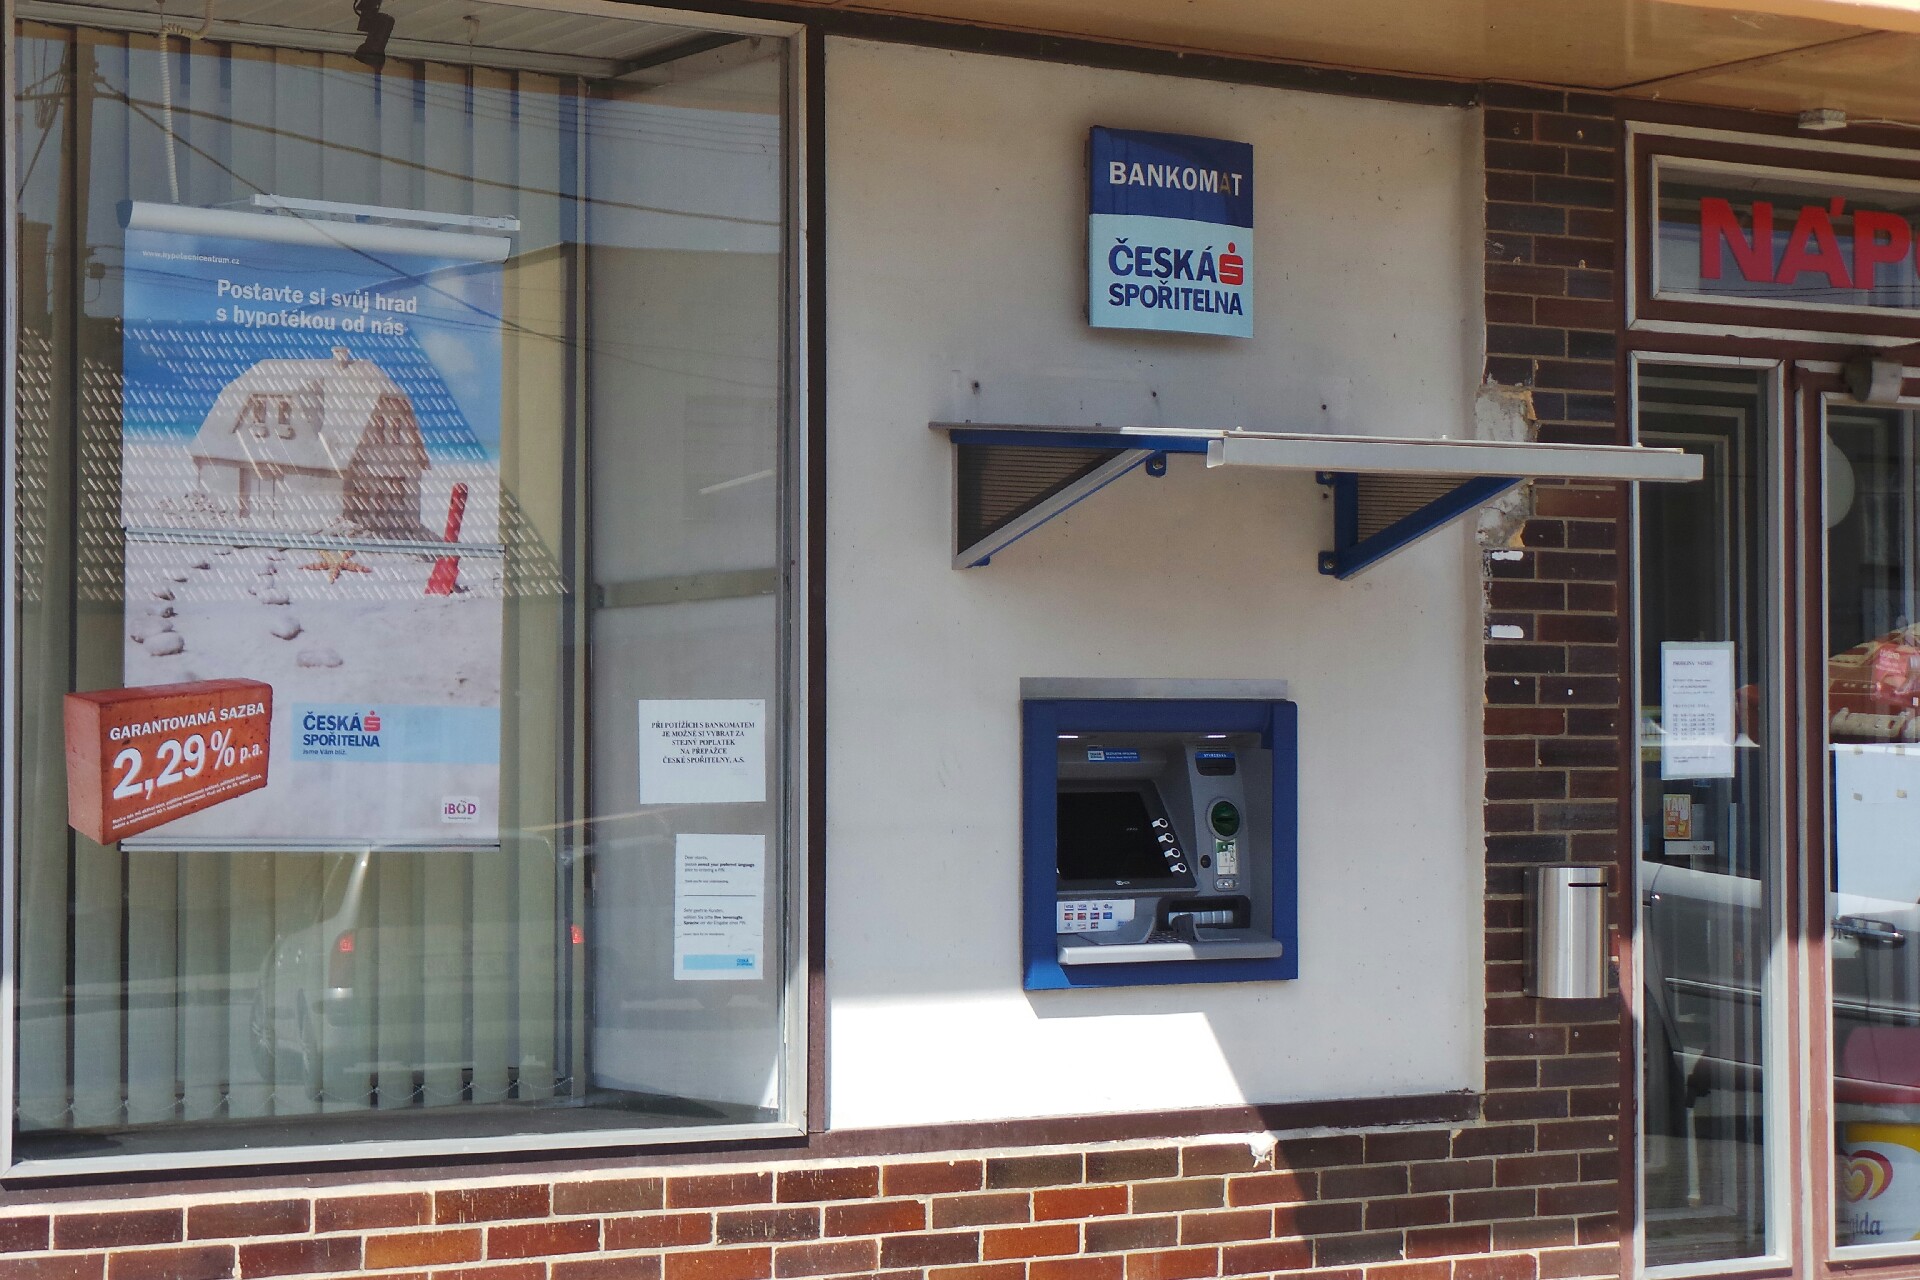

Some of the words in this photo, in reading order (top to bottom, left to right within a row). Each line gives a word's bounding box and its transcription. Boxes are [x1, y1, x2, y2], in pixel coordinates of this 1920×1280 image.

[1109, 161, 1243, 196] BANKOMAT
[1699, 196, 1920, 291] NÁP
[1108, 237, 1218, 284] ČESKÁ
[217, 279, 304, 304] Postavte
[309, 288, 326, 305] si
[331, 290, 369, 313] svůj
[375, 293, 417, 313] hrad
[1108, 280, 1243, 316] SPOŘITELNA
[216, 308, 227, 322] s
[233, 305, 335, 331] hypotékou
[341, 315, 364, 333] od
[371, 317, 405, 336] nás
[110, 708, 217, 741] GARANTOVANÁ
[219, 702, 265, 721] SAZBA
[303, 711, 362, 731] ČESKÁ
[705, 721, 755, 729] BANKOMATEM
[239, 743, 263, 764] p.a.
[303, 732, 380, 748] SPOŘITELNA
[662, 755, 685, 764] ČESKÉ
